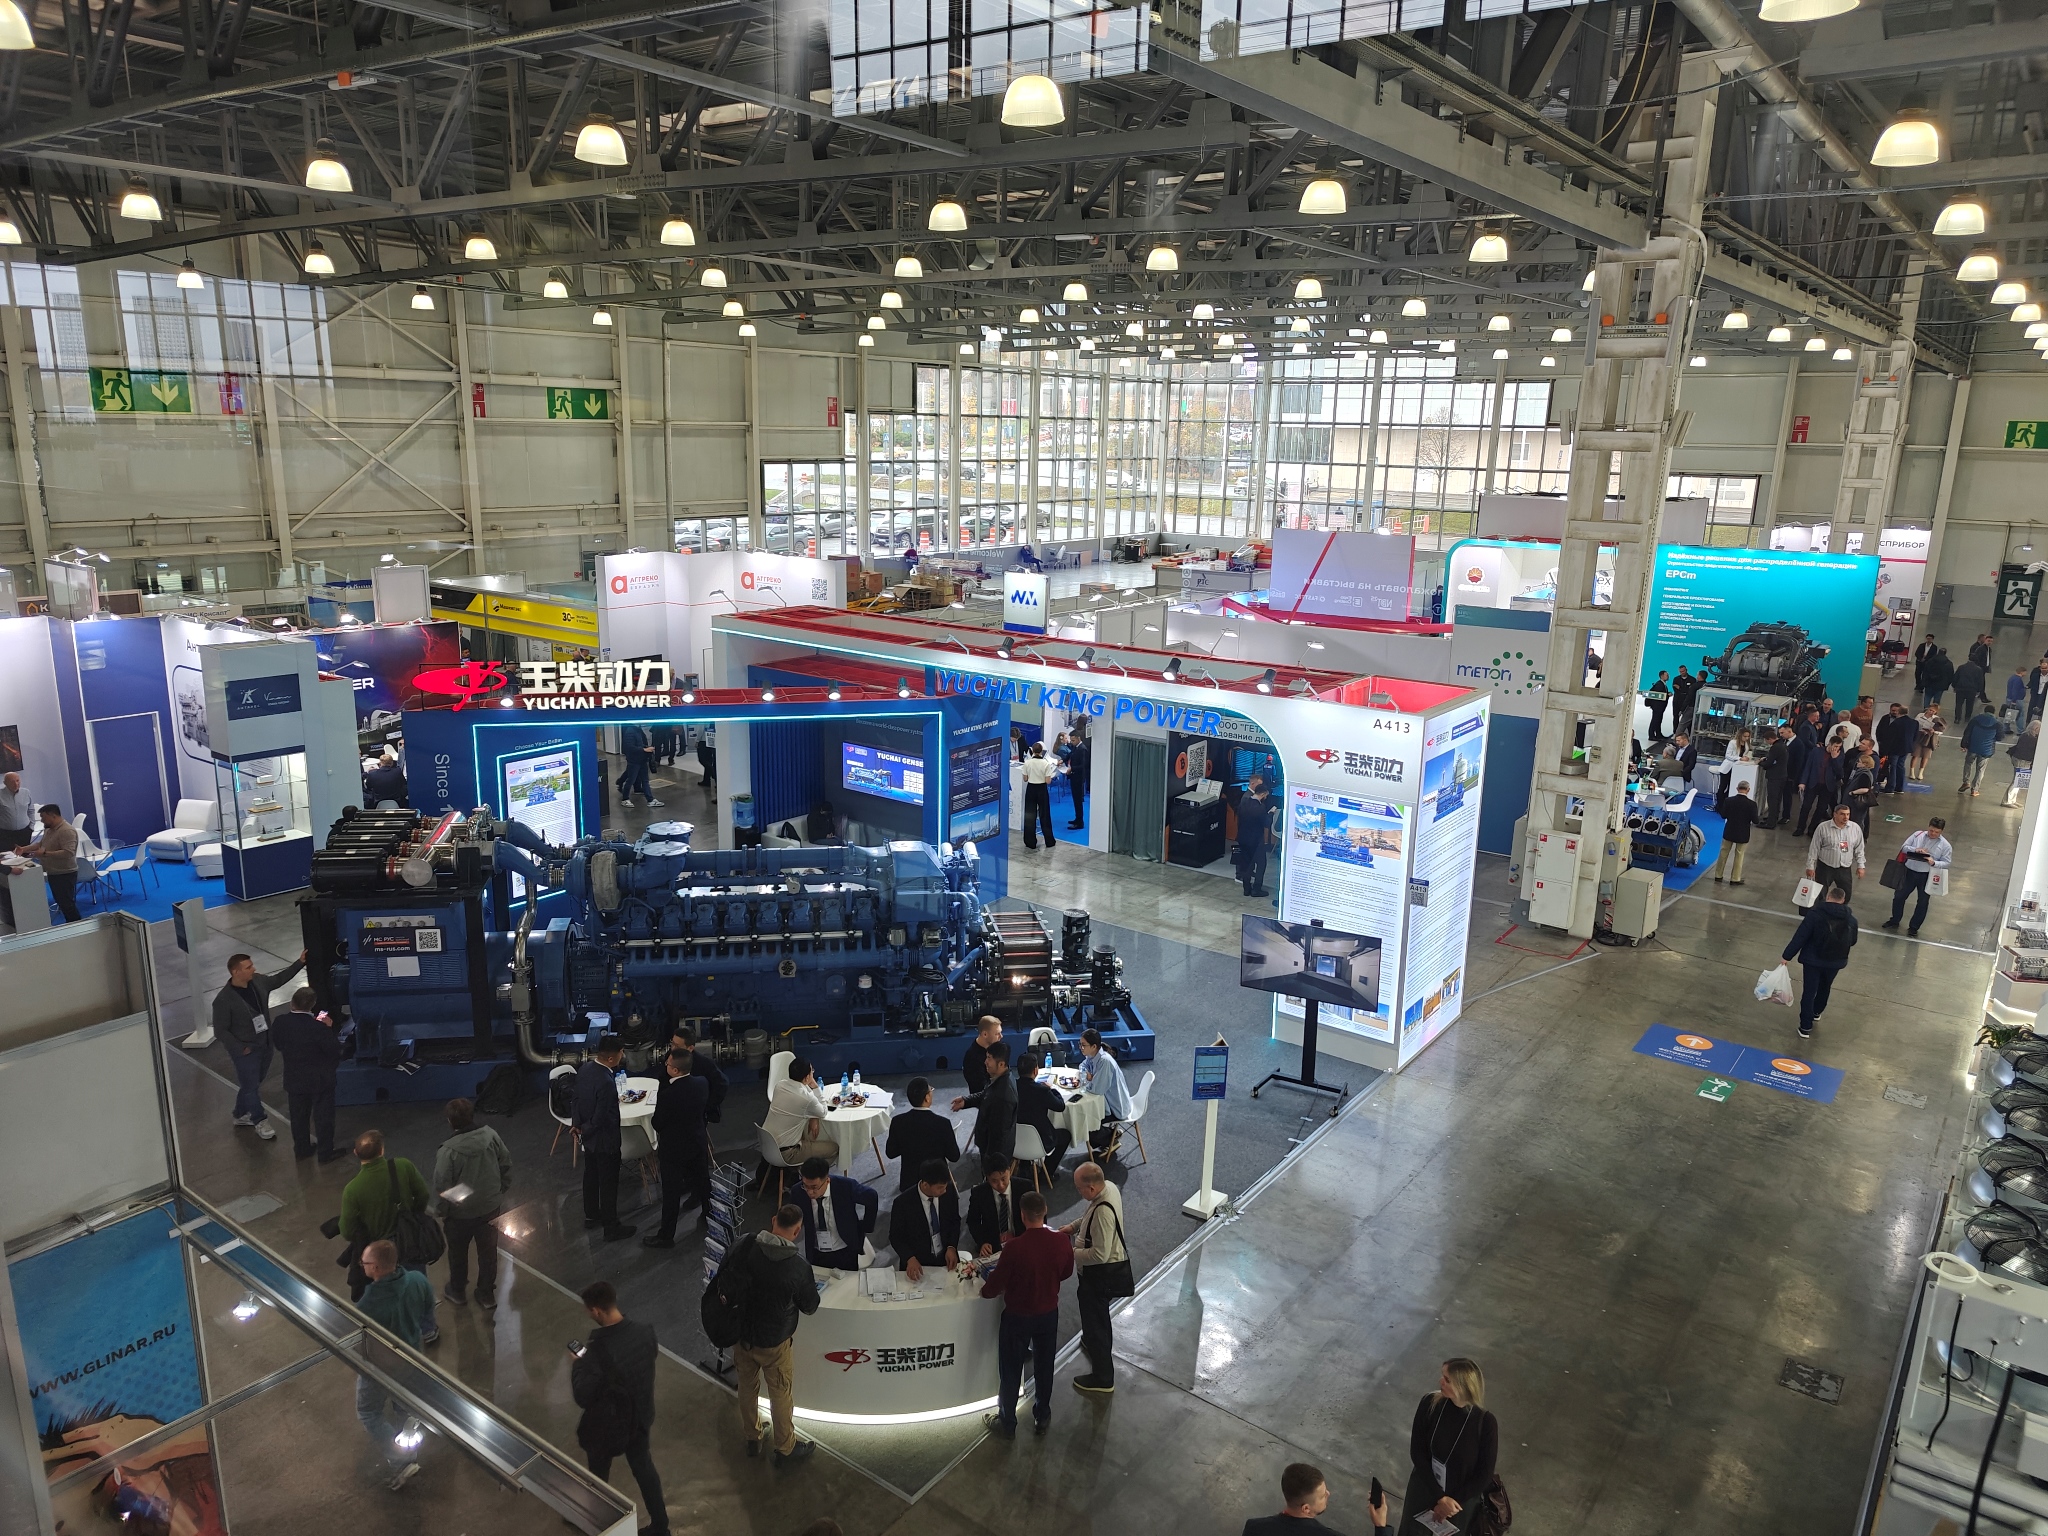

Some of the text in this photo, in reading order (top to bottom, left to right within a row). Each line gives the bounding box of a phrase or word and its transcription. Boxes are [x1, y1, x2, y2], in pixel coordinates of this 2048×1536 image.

[629, 575, 659, 584] АГГРЕКО
[756, 575, 782, 584] АГГРЕКО
[1596, 576, 1611, 586] ex
[352, 677, 375, 690] ER
[521, 660, 671, 693] 玉柴动力
[523, 694, 671, 711] YUCHAI POWER
[937, 669, 1223, 736] YUCHAI KING POWER
[983, 719, 999, 730] POWER
[1372, 717, 1411, 734] A413
[876, 752, 924, 768] YUCHAI GENSE
[1343, 750, 1404, 775] 玉柴动力
[434, 753, 450, 798] Since
[1343, 766, 1403, 783] YUCHAI POWER
[1409, 884, 1427, 893] A413
[876, 1343, 955, 1366] 玉柴动力
[877, 1359, 955, 1373] YUCHAI POWER
